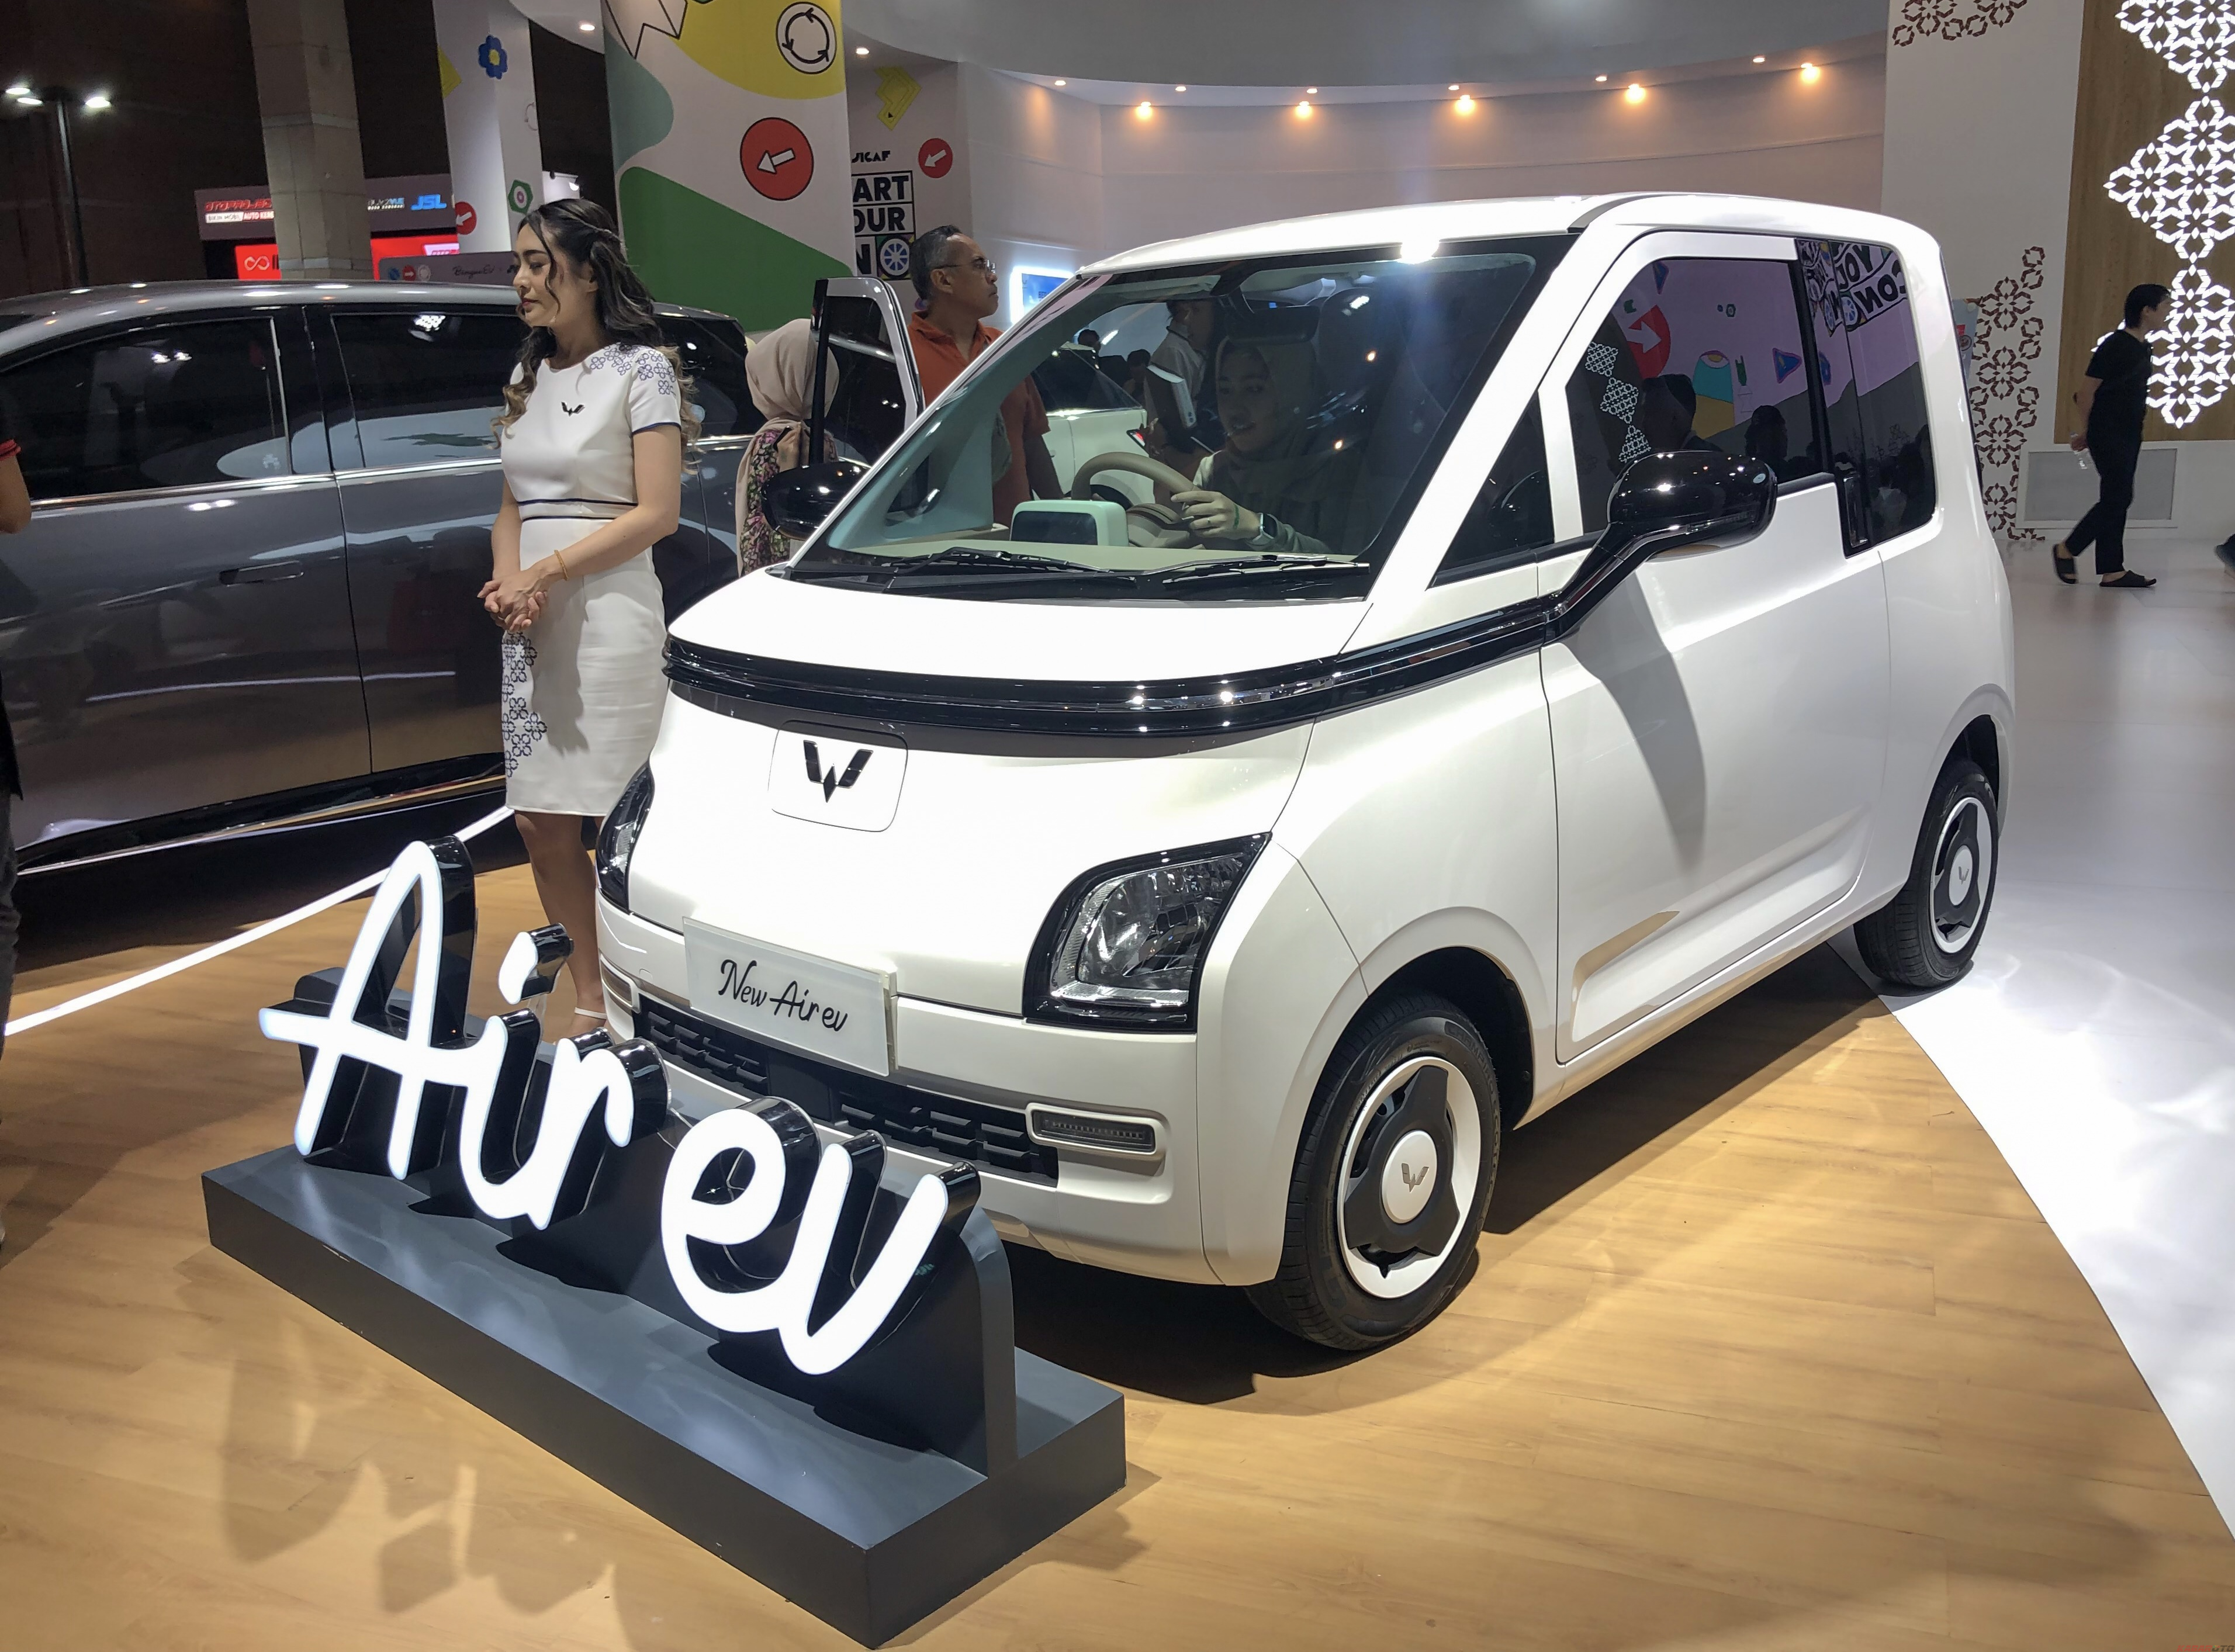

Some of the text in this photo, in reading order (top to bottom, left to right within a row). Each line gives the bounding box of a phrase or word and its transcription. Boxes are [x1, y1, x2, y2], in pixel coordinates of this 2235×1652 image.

[411, 194, 447, 210] JSL
[718, 959, 767, 1007] New
[258, 840, 949, 1375] Air ev
